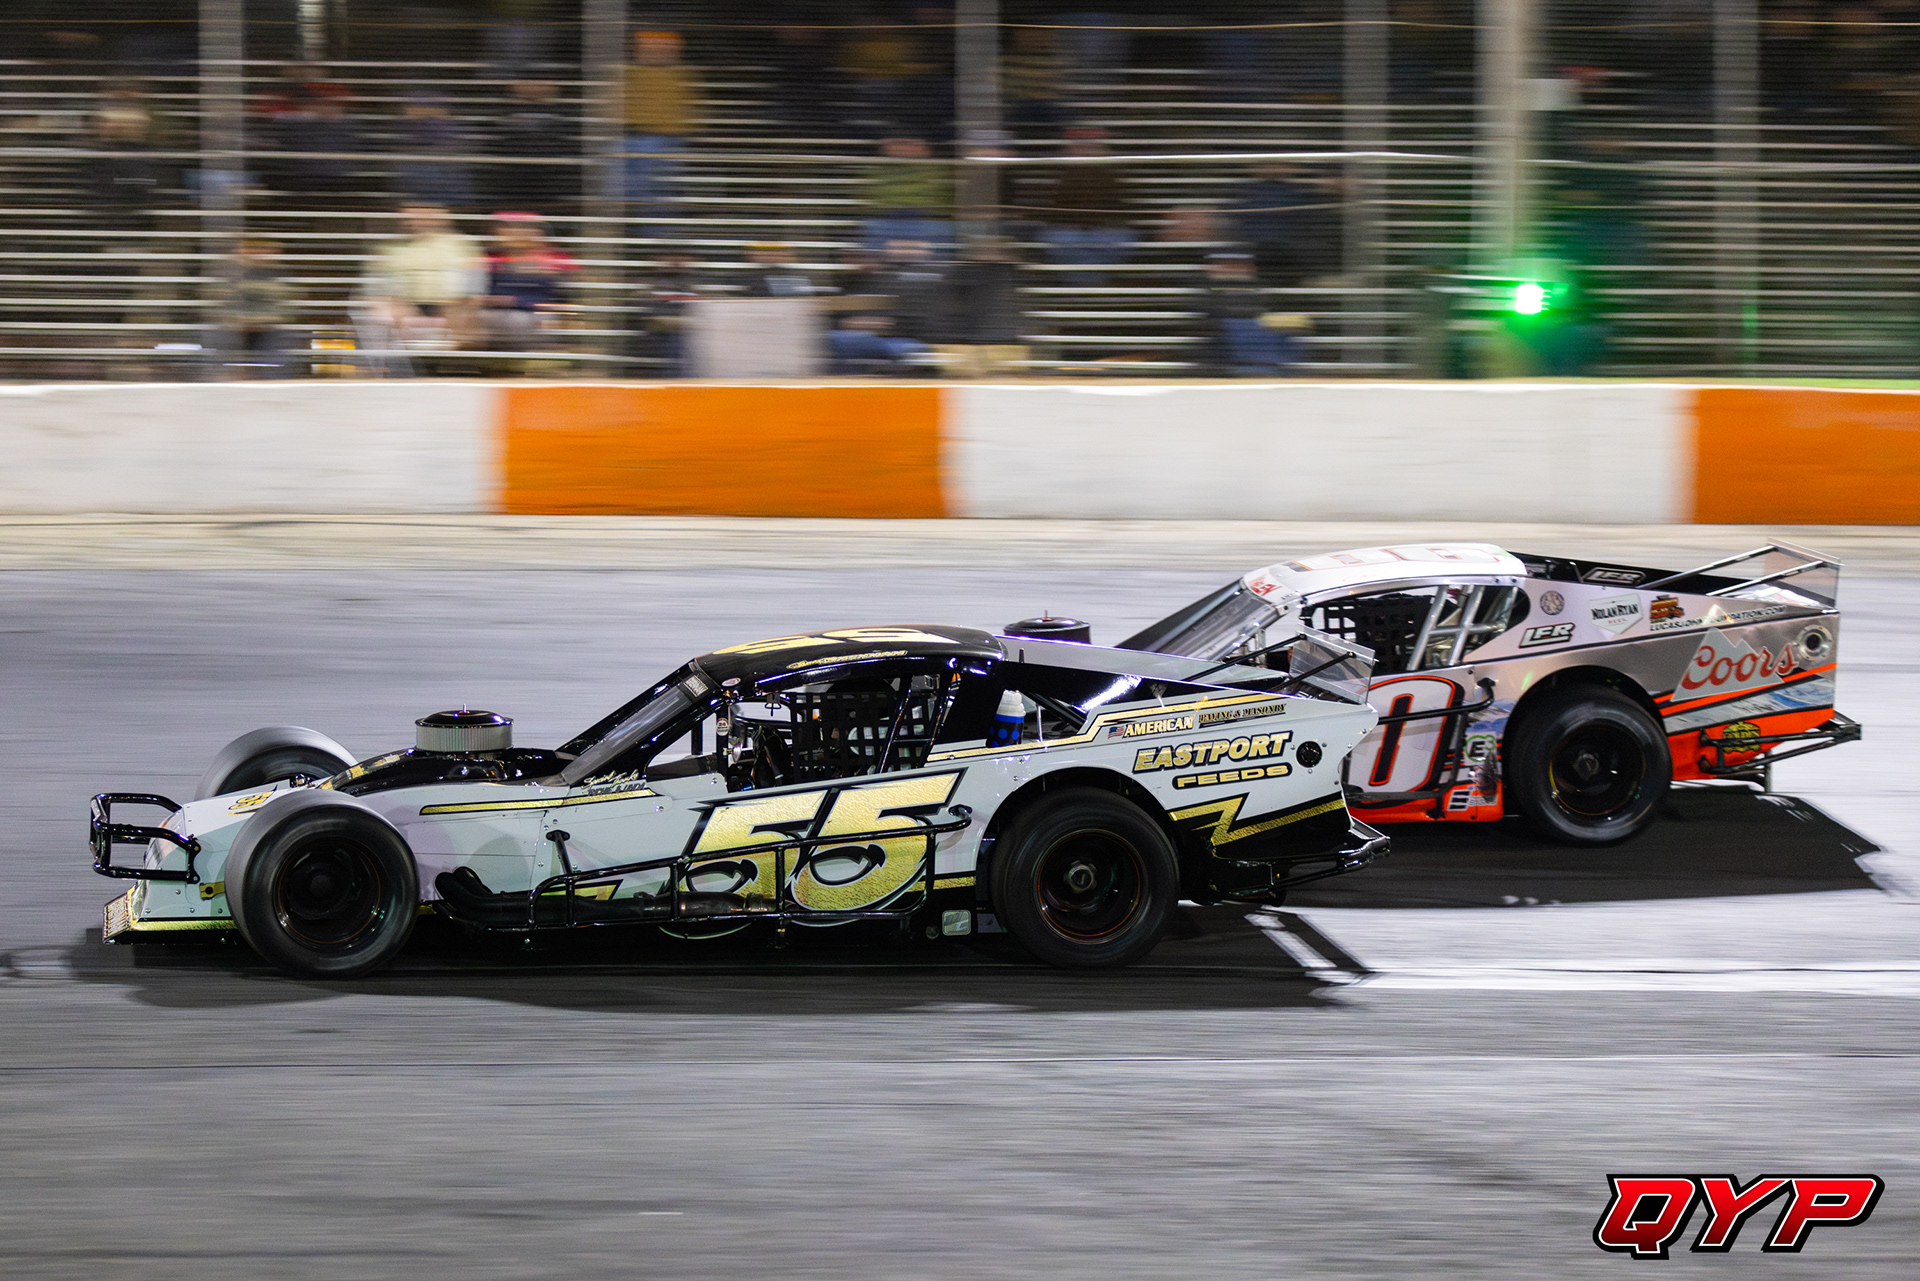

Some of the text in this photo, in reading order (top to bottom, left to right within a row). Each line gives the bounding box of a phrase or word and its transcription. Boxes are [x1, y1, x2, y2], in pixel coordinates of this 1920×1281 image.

[1585, 569, 1644, 585] LFR
[1592, 606, 1617, 620] NOLAN
[1617, 603, 1639, 616] RYAN
[1519, 622, 1575, 648] LFR
[1681, 643, 1798, 690] Coors
[1123, 703, 1287, 738] AMERICAN PAVING & MASONRY
[1132, 730, 1293, 774] EASTPORT
[1177, 764, 1289, 788] FEEDS
[676, 769, 966, 930] 55
